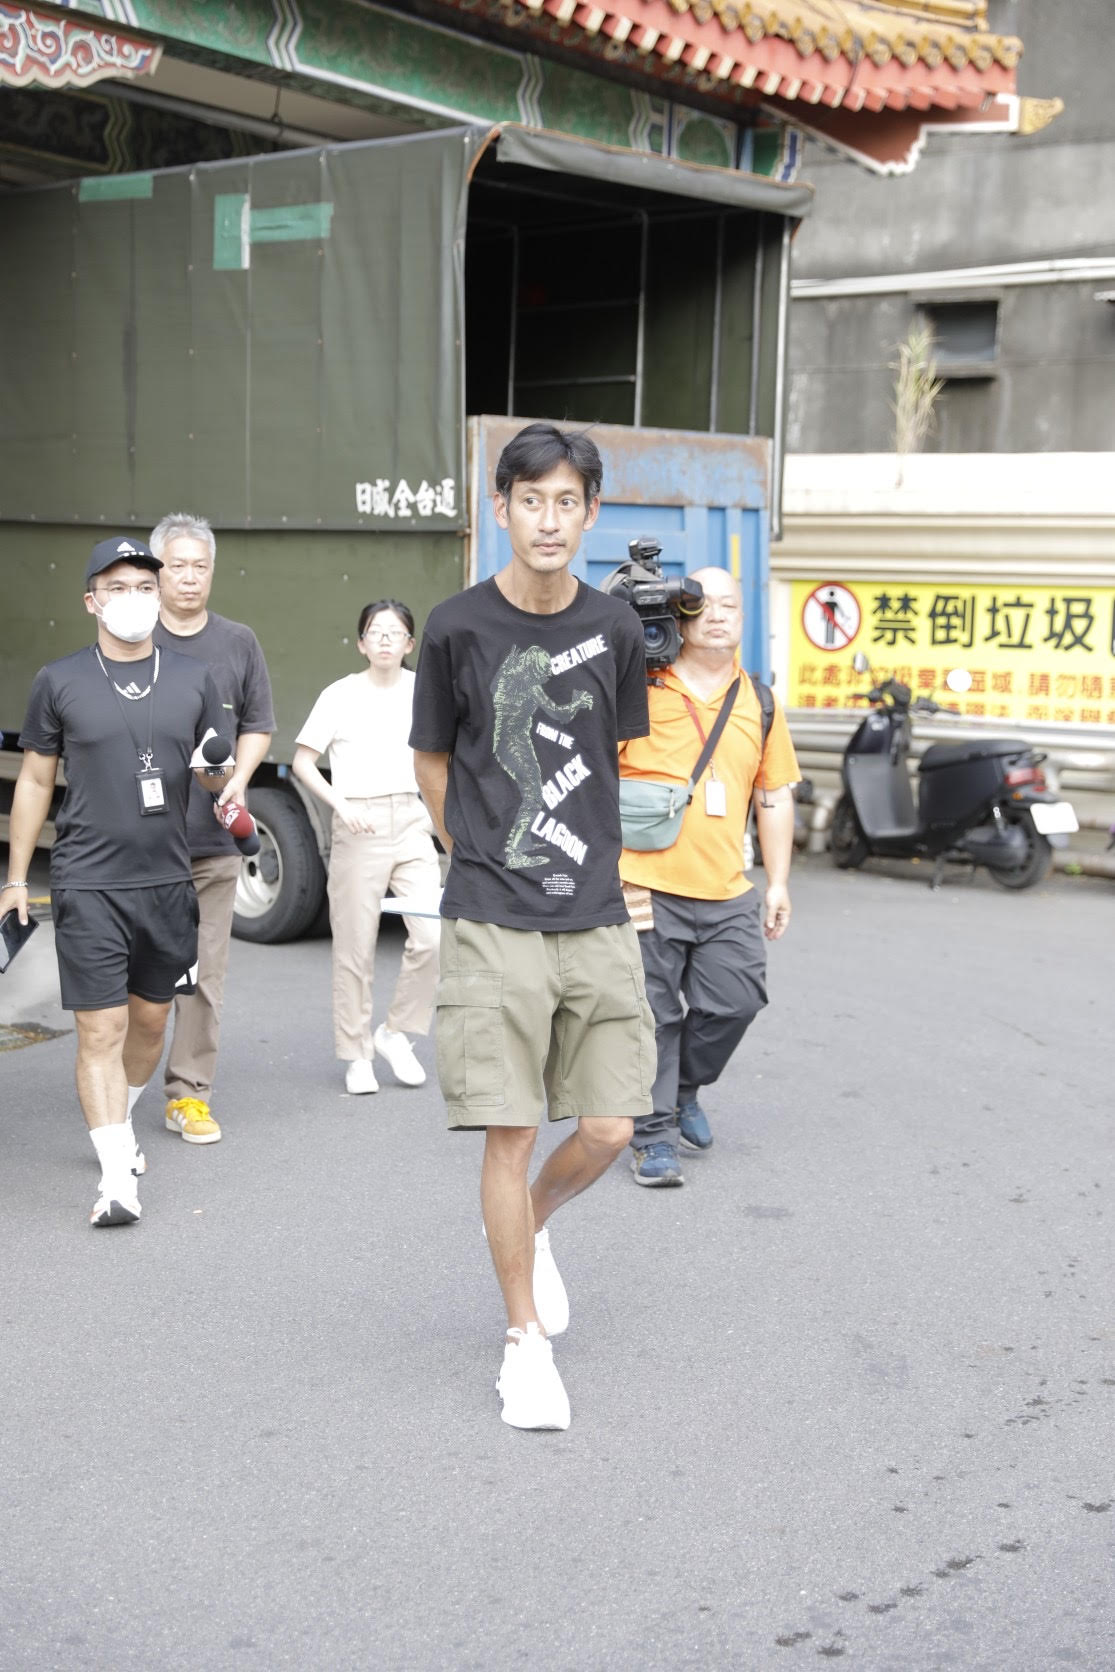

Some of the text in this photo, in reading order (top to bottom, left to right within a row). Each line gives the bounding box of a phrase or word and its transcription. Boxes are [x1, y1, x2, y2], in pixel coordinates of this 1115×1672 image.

[872, 592, 1094, 652] 禁倒垃圾
[550, 634, 608, 675] CREATURE
[536, 721, 575, 750] FROM THE
[542, 754, 592, 810] BLACK
[531, 811, 588, 866] LAGOON
